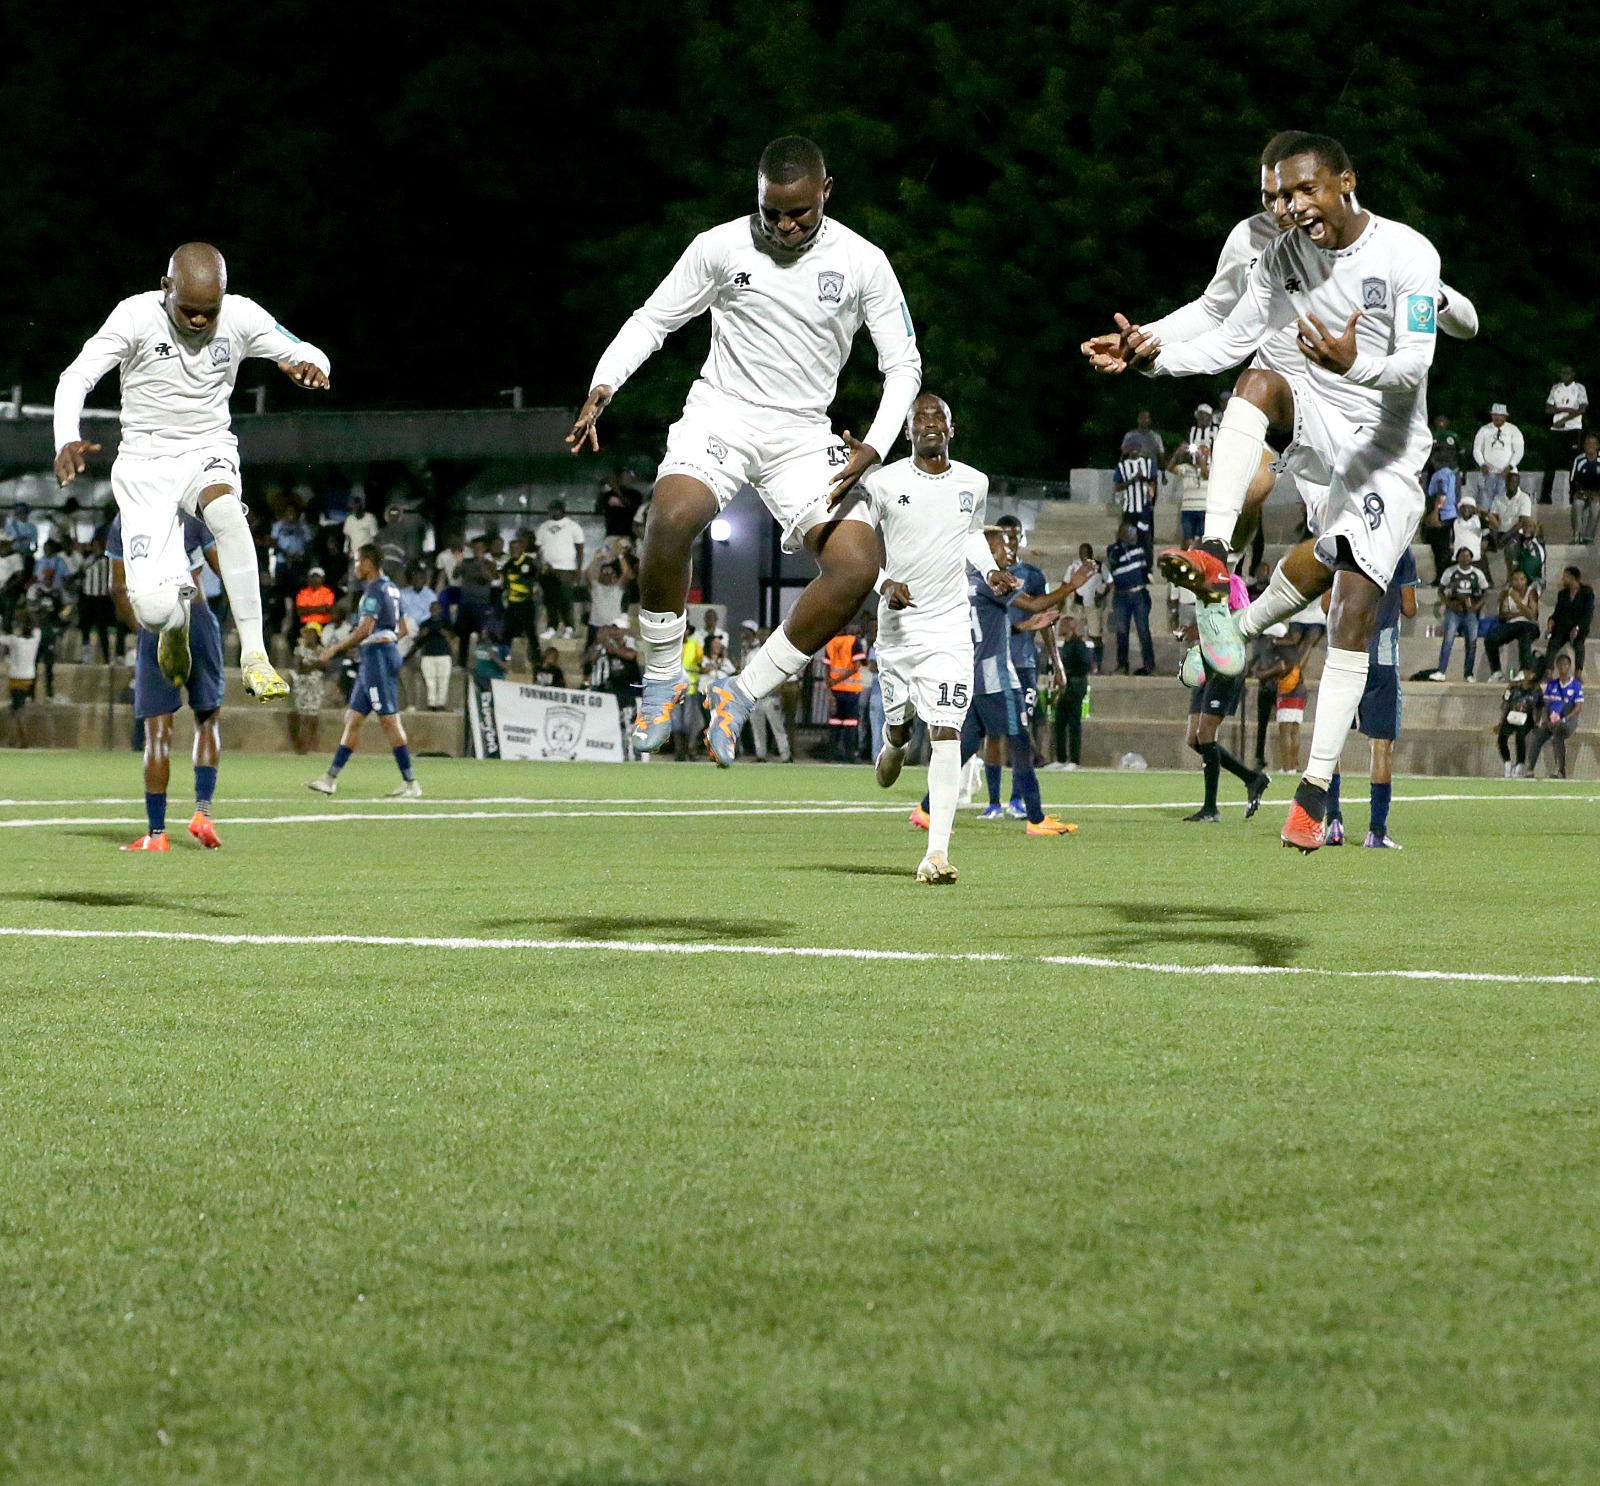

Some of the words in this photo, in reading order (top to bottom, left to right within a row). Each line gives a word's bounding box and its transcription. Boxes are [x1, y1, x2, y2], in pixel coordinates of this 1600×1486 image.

[520, 686, 568, 703] FORWARD
[571, 693, 586, 706] WE
[588, 695, 603, 707] GO
[937, 682, 968, 709] 15
